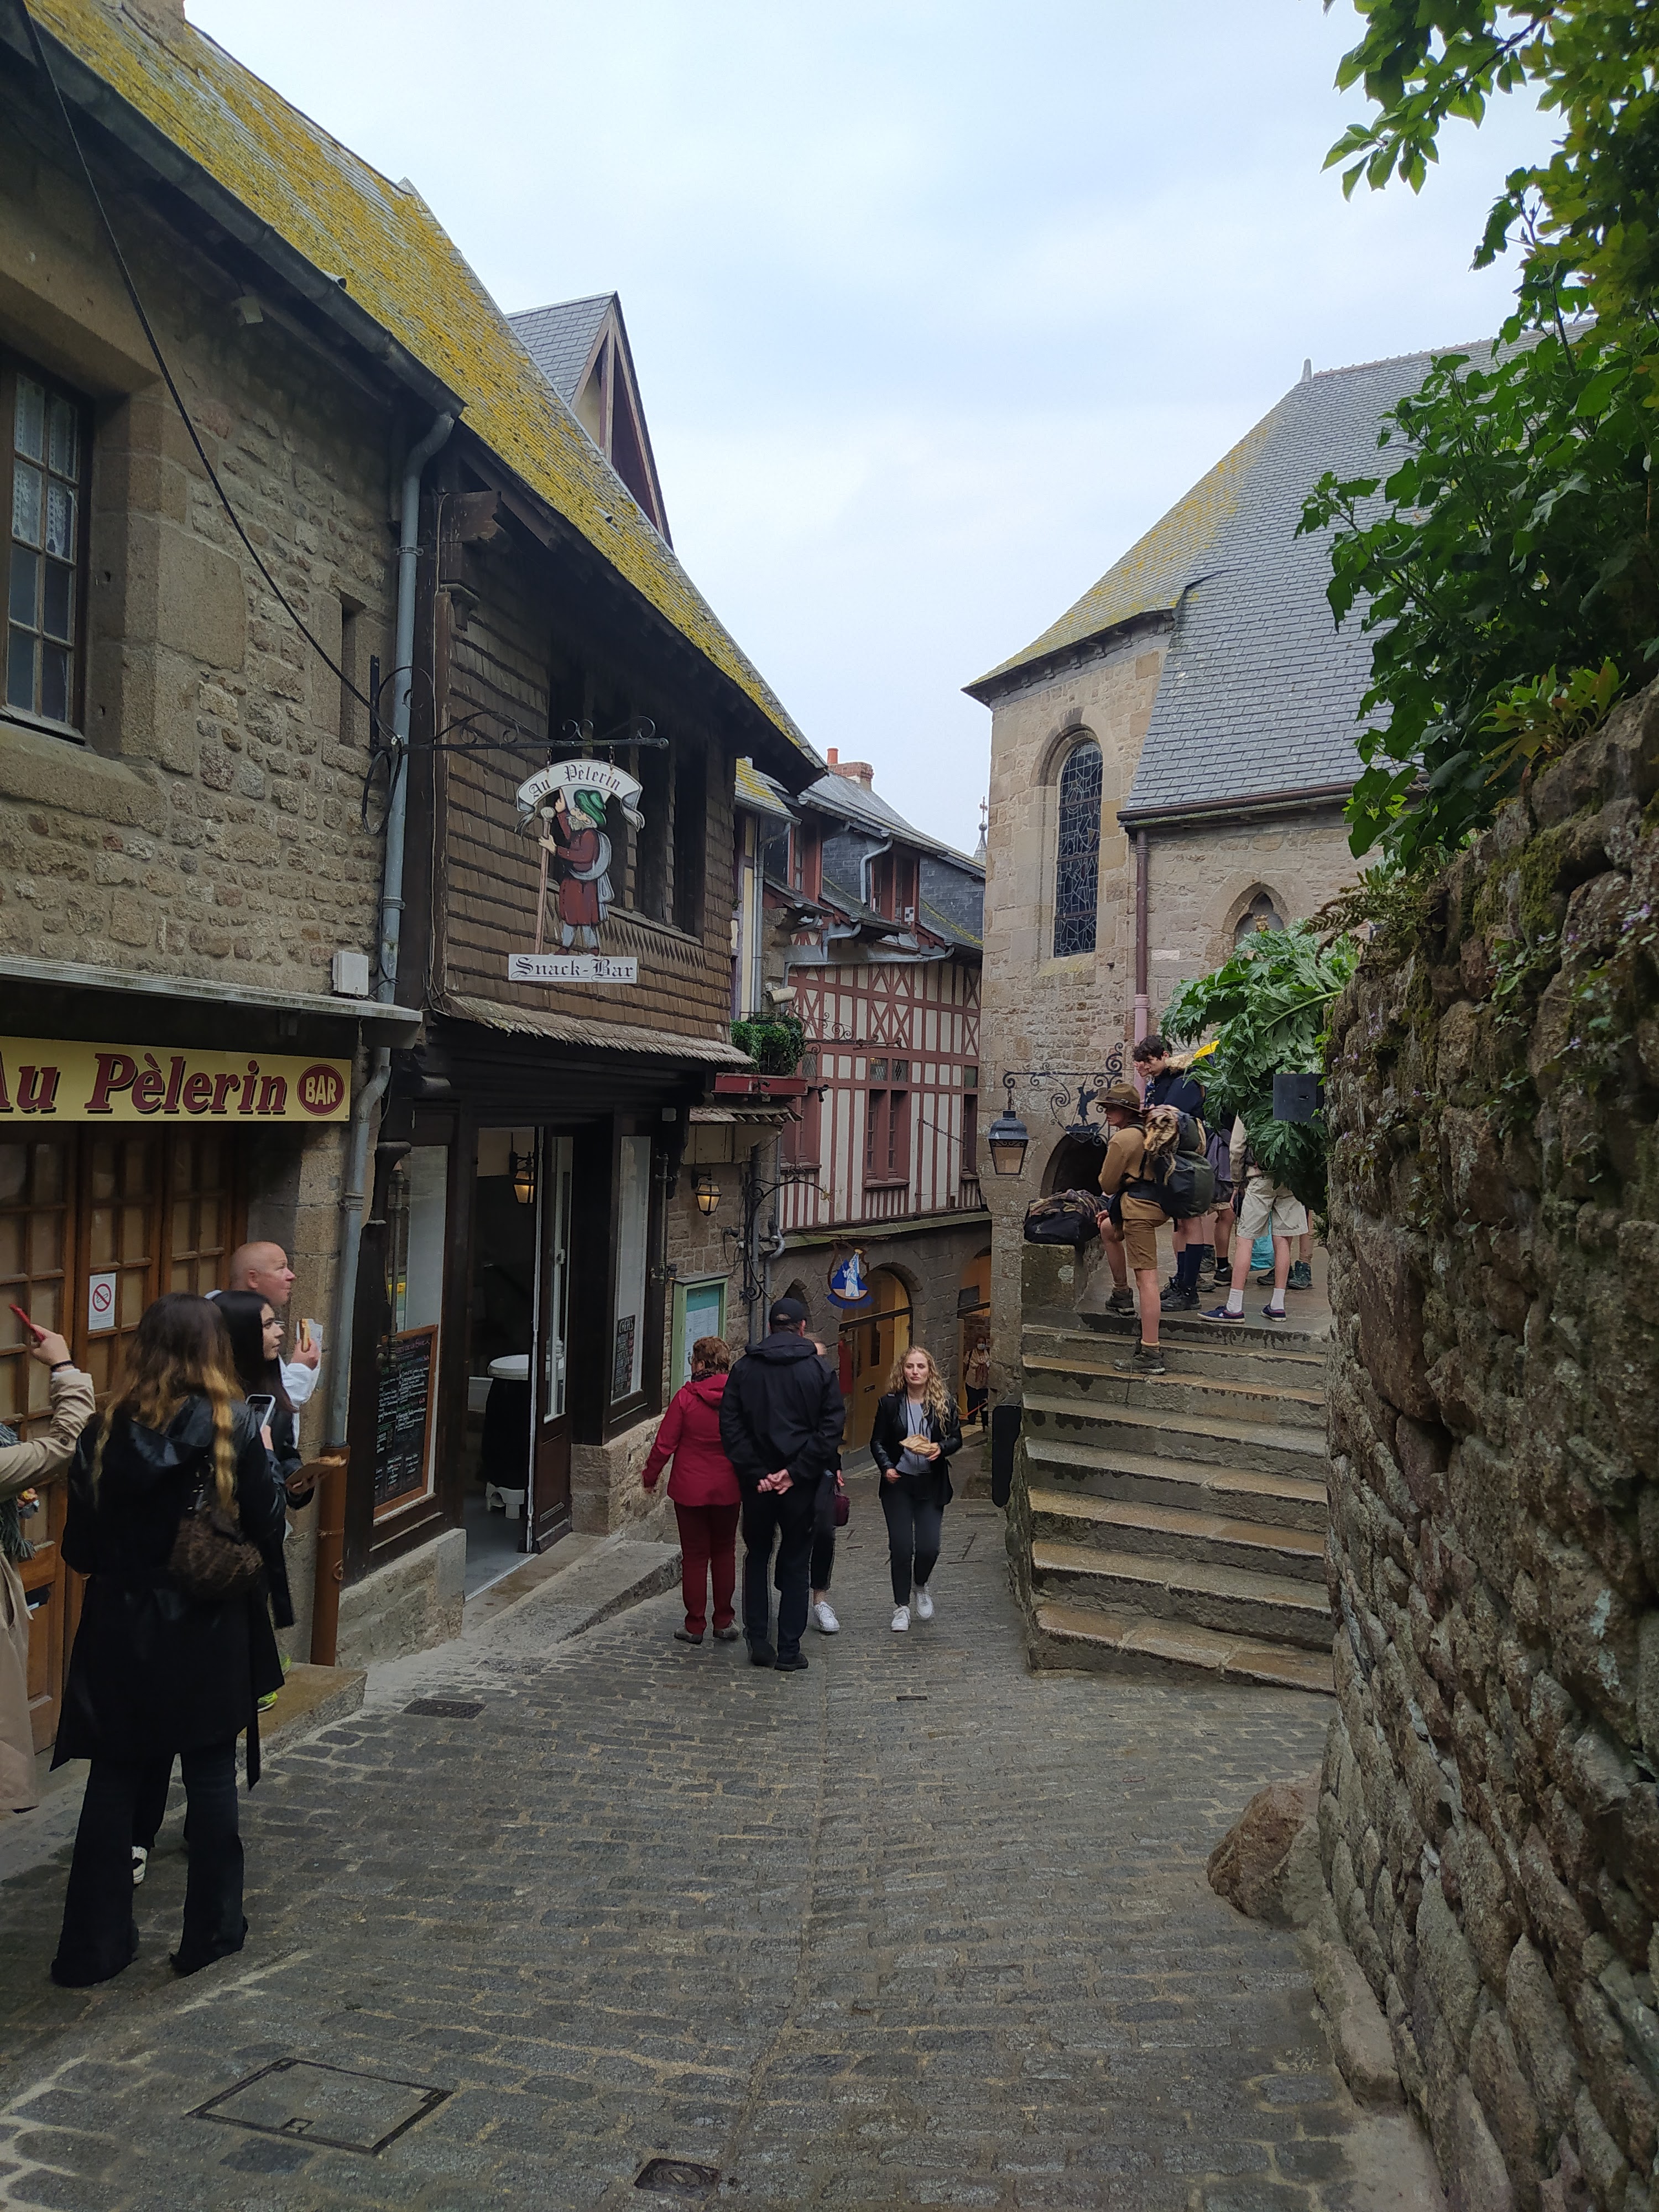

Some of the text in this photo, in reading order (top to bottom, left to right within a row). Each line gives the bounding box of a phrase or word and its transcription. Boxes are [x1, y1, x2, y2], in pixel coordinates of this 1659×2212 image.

[529, 764, 622, 800] Au Pèlerin
[510, 957, 634, 982] Snack-Bar
[0, 1052, 287, 1114] u Pèlerin
[305, 1074, 337, 1105] BAR
